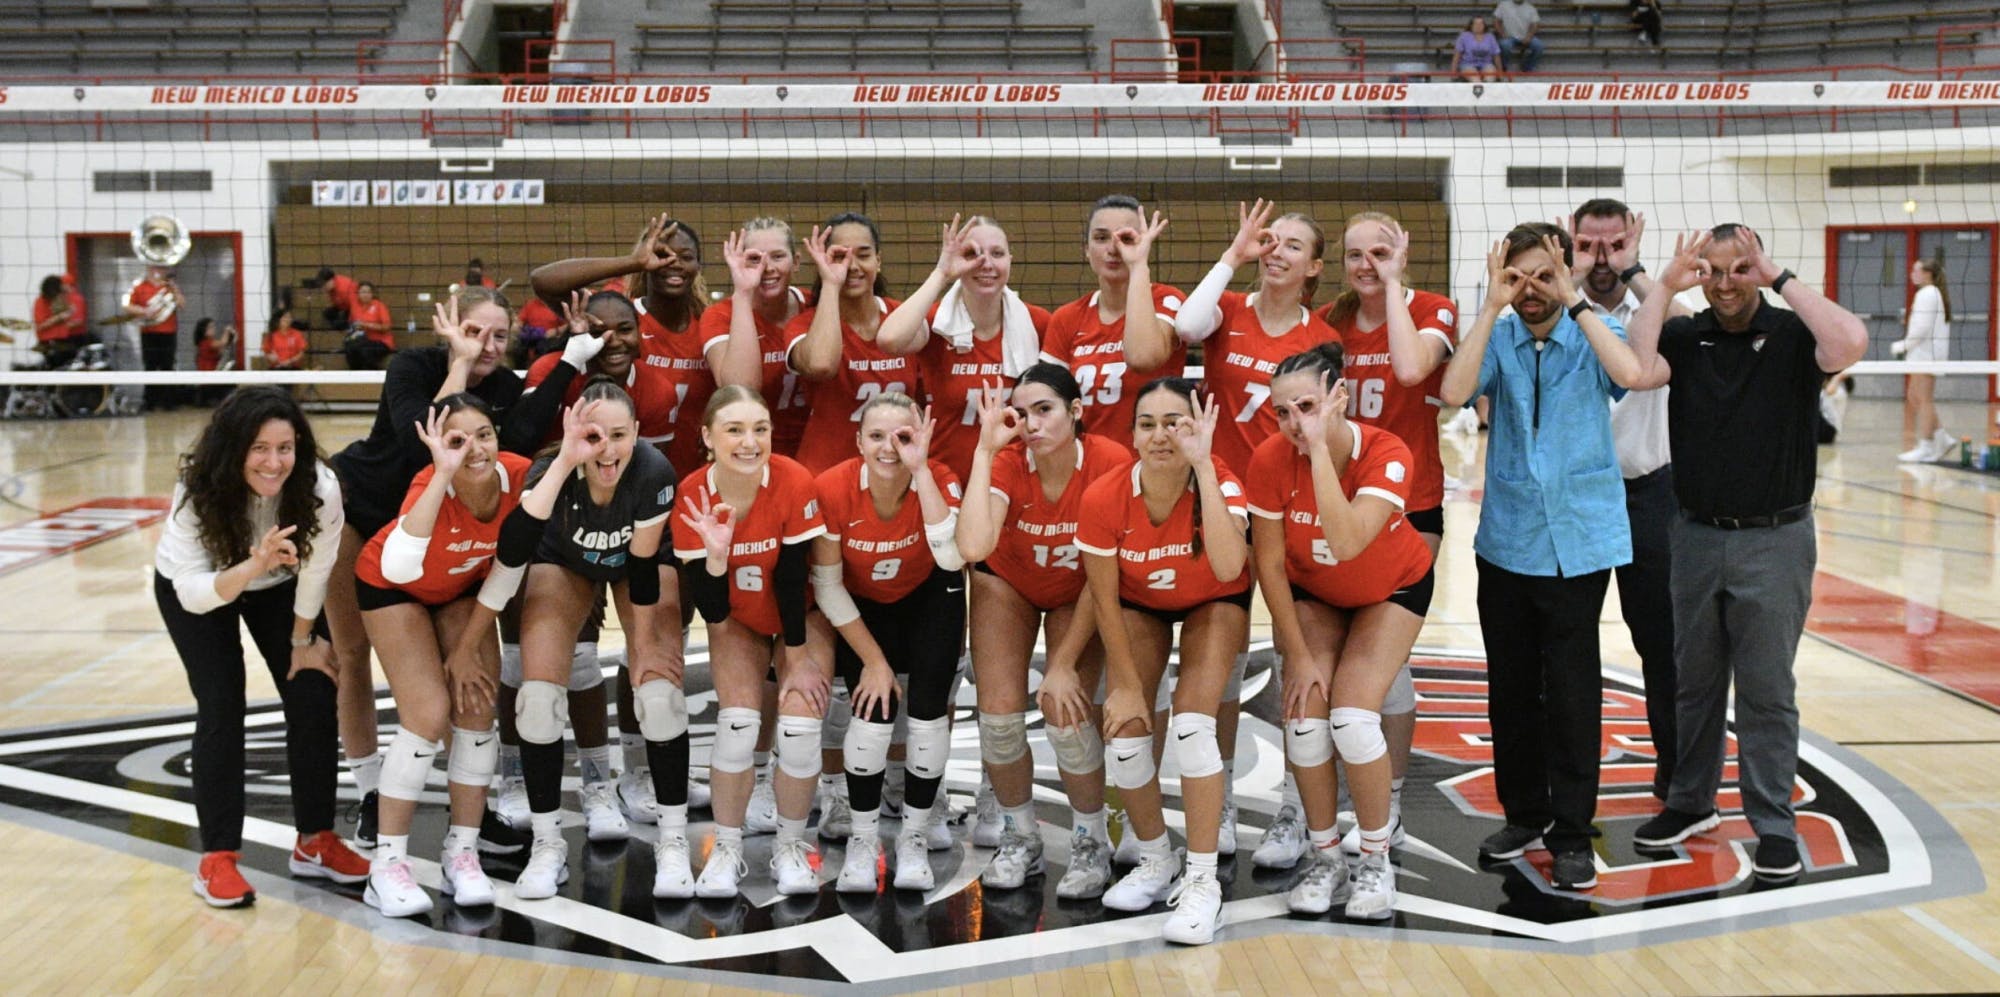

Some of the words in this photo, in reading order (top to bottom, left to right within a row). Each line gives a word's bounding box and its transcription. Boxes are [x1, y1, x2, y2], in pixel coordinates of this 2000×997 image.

[152, 87, 198, 104] NEW
[204, 87, 286, 104] MEXICO
[292, 87, 359, 104] LOBOS
[502, 86, 549, 103] NEW
[556, 86, 638, 103] MEXICO
[643, 86, 710, 103] LOBOS
[853, 86, 901, 102] NEW
[906, 85, 988, 102] MEXICO
[993, 85, 1060, 102] LOBOS
[1202, 84, 1249, 101] NEW
[1255, 84, 1337, 101] MEXICO
[1342, 84, 1407, 101] LOBOS
[1547, 84, 1594, 100] NEW
[1599, 84, 1680, 100] MEXICO
[1685, 83, 1749, 99] LOBOS
[1887, 83, 1933, 99] NEW
[1938, 83, 2000, 99] MEXIC
[646, 354, 671, 368] NEW
[1226, 352, 1254, 368] NEW
[1356, 353, 1391, 366] MEXIC
[952, 364, 978, 375] NEW
[1075, 362, 1127, 405] 23
[1234, 381, 1271, 422] 7
[1345, 378, 1385, 418] 16
[1017, 520, 1043, 536] NEW
[572, 525, 633, 550] LOBOS
[847, 538, 875, 552] NEW
[876, 532, 920, 553] MEXICO
[733, 537, 777, 556] MEXICO
[1312, 538, 1339, 566] 5
[1033, 544, 1079, 570] 12
[1120, 548, 1145, 563] NEW
[871, 558, 902, 581] 9
[735, 565, 763, 592] 6
[1147, 568, 1176, 590] 2
